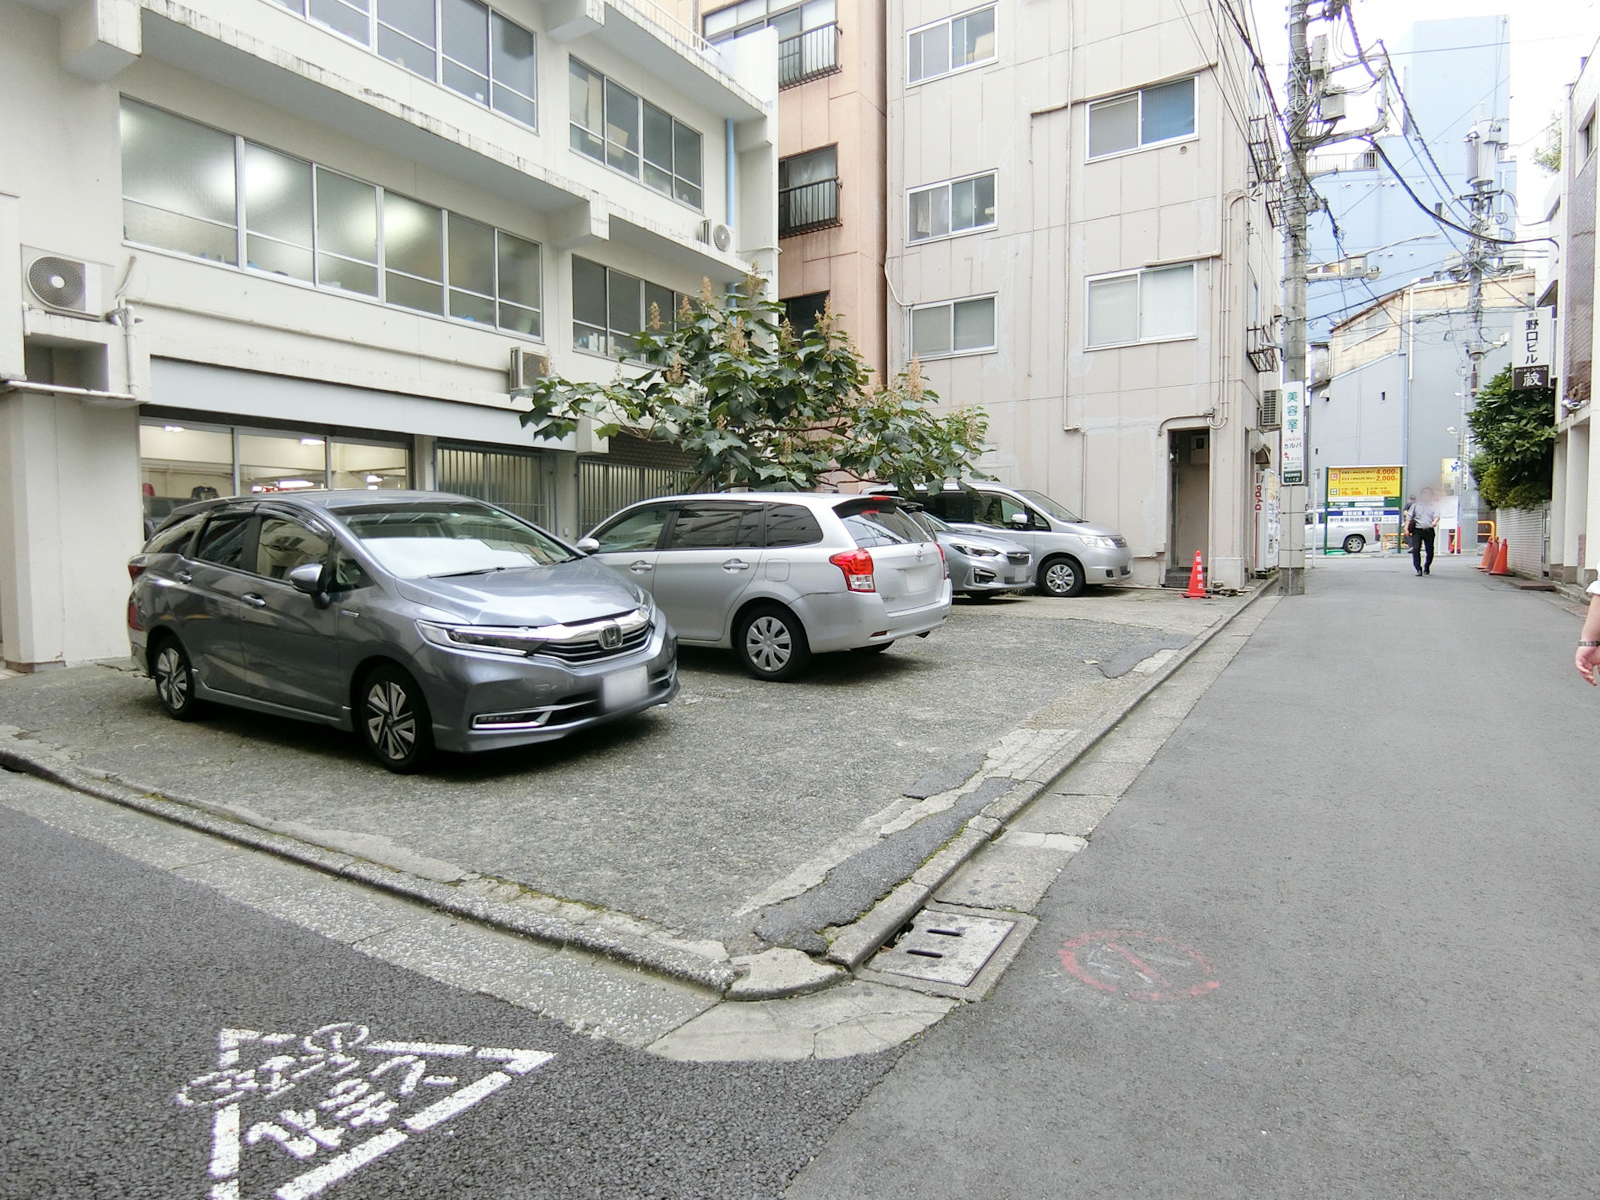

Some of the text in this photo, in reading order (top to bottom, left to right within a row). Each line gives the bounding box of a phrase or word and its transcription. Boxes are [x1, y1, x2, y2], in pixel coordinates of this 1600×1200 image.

[1522, 371, 1542, 387] 蔵
[1287, 391, 1298, 430] 美容室
[1254, 484, 1264, 511] DyDo
